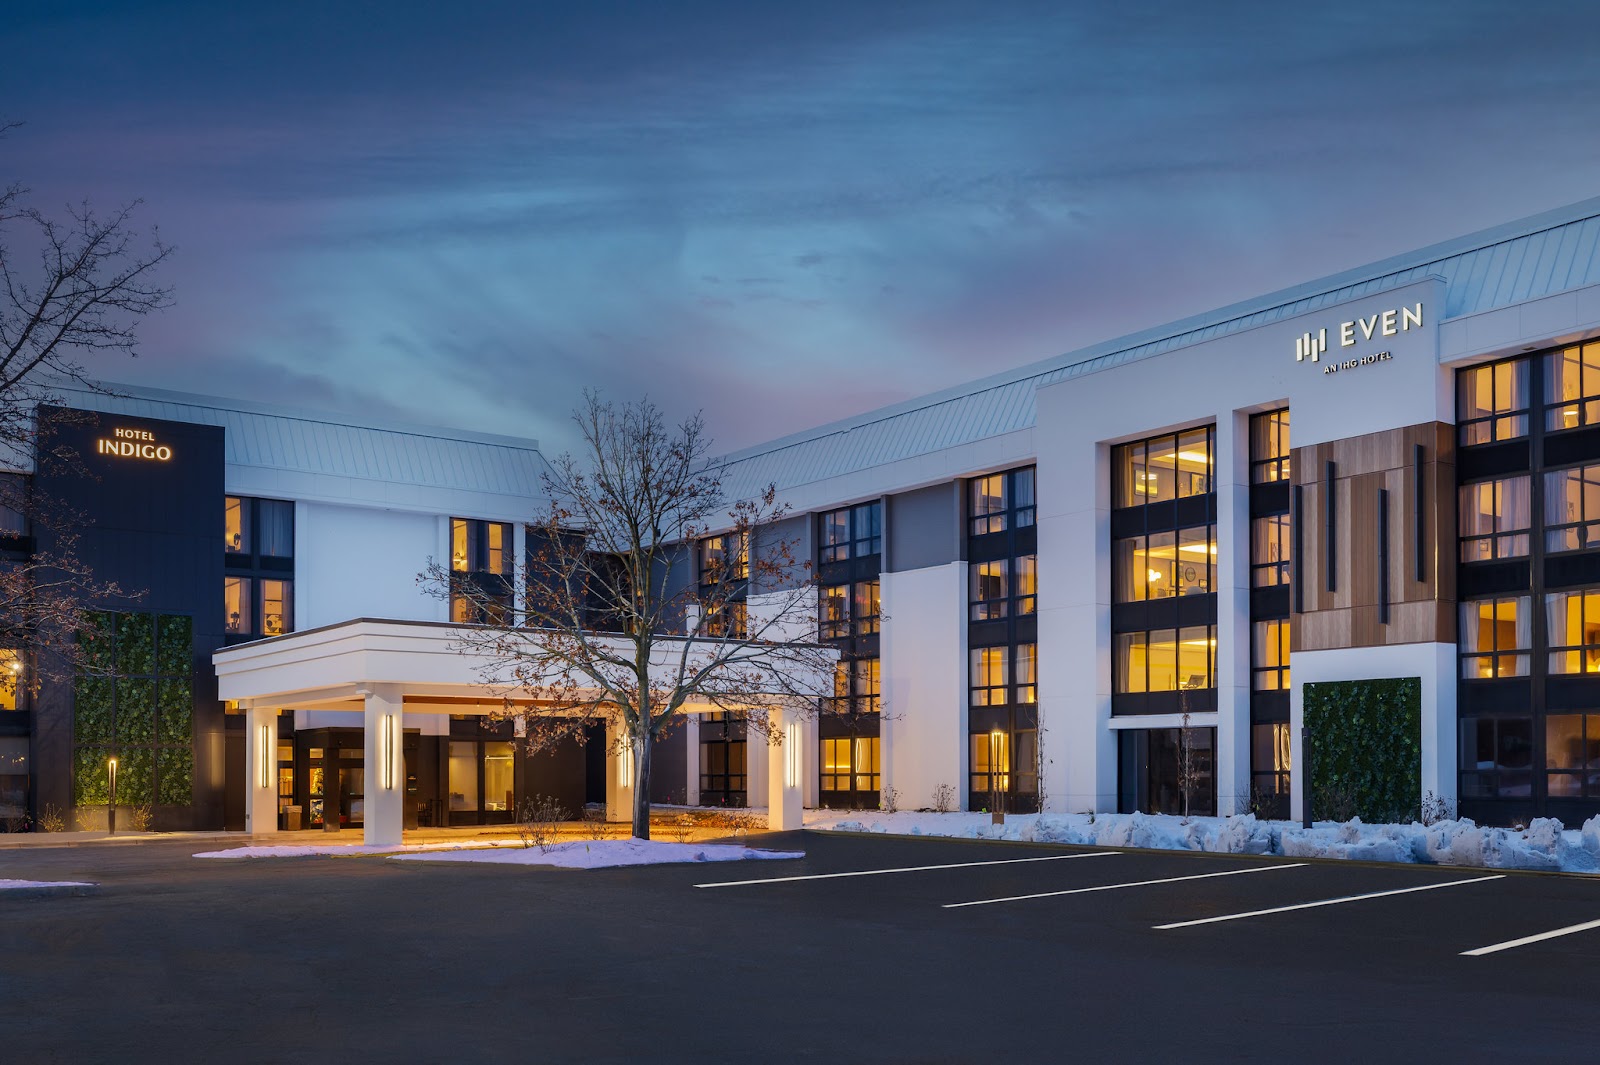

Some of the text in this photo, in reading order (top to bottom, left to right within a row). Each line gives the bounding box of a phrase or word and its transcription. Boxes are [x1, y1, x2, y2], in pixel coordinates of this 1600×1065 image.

[1341, 302, 1422, 346] EVEN
[1323, 351, 1393, 375] AN IHG HOTEL
[115, 428, 155, 441] HOTEL
[98, 439, 172, 461] INDIGO
